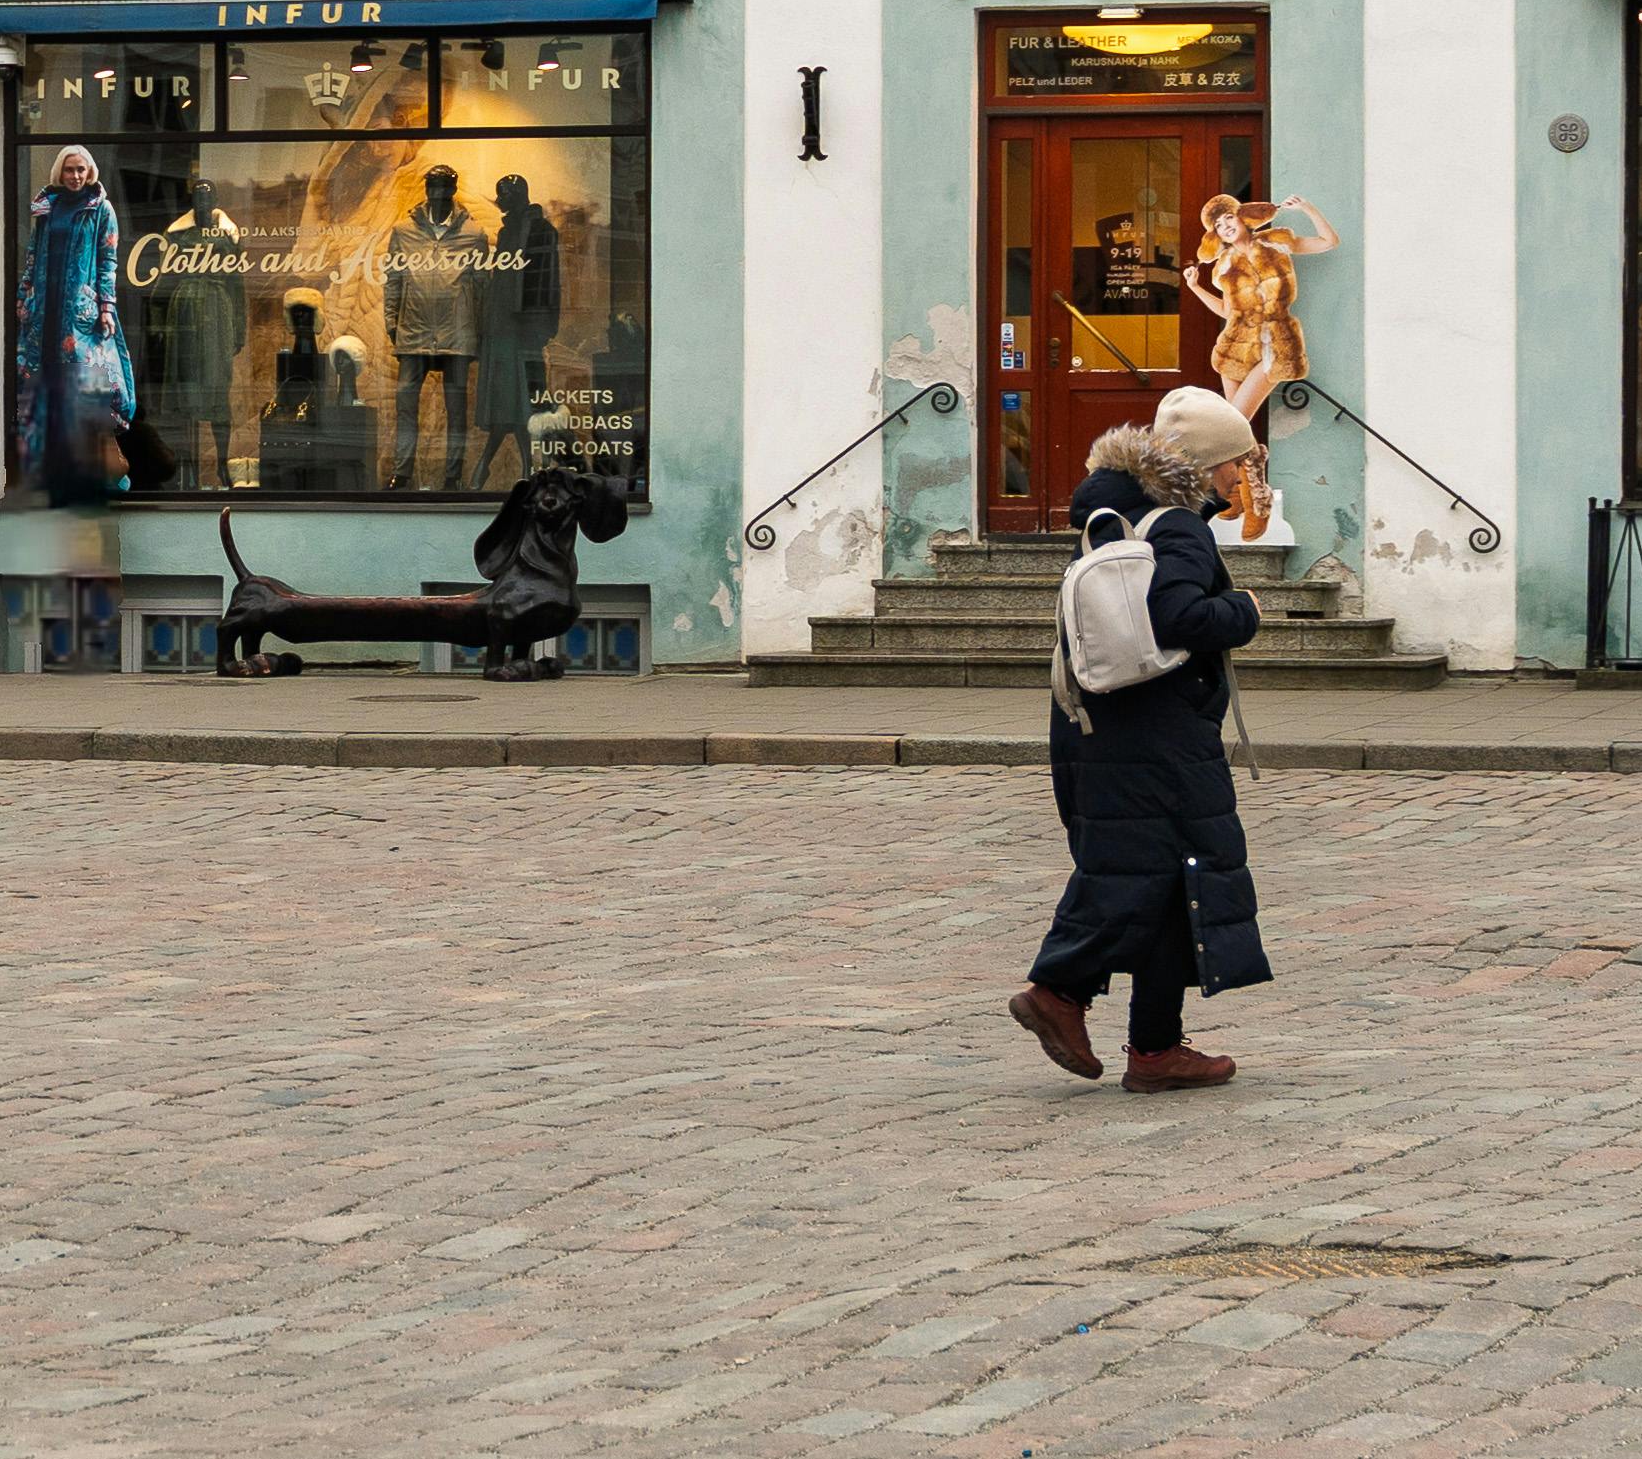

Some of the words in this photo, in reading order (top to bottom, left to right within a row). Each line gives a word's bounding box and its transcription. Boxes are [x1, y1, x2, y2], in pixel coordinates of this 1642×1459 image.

[218, 2, 382, 27] INFUR
[1009, 36, 1039, 49] FUR
[1044, 37, 1054, 49] &
[1059, 35, 1127, 48] LEATHER
[1071, 56, 1136, 66] KARUSNAHK
[1150, 56, 1179, 66] NAHK
[37, 76, 191, 99] INFUR
[1008, 77, 1035, 86] PELZ
[1037, 76, 1055, 86] und
[1058, 76, 1093, 86] LEDER
[252, 226, 267, 237] JA
[126, 232, 256, 287] Clothes
[261, 247, 332, 273] and
[329, 232, 531, 286] Accessories
[1110, 247, 1143, 258] 9-19
[530, 389, 613, 404] JACKETS
[531, 440, 566, 455] FUR
[571, 440, 634, 456] COATS
